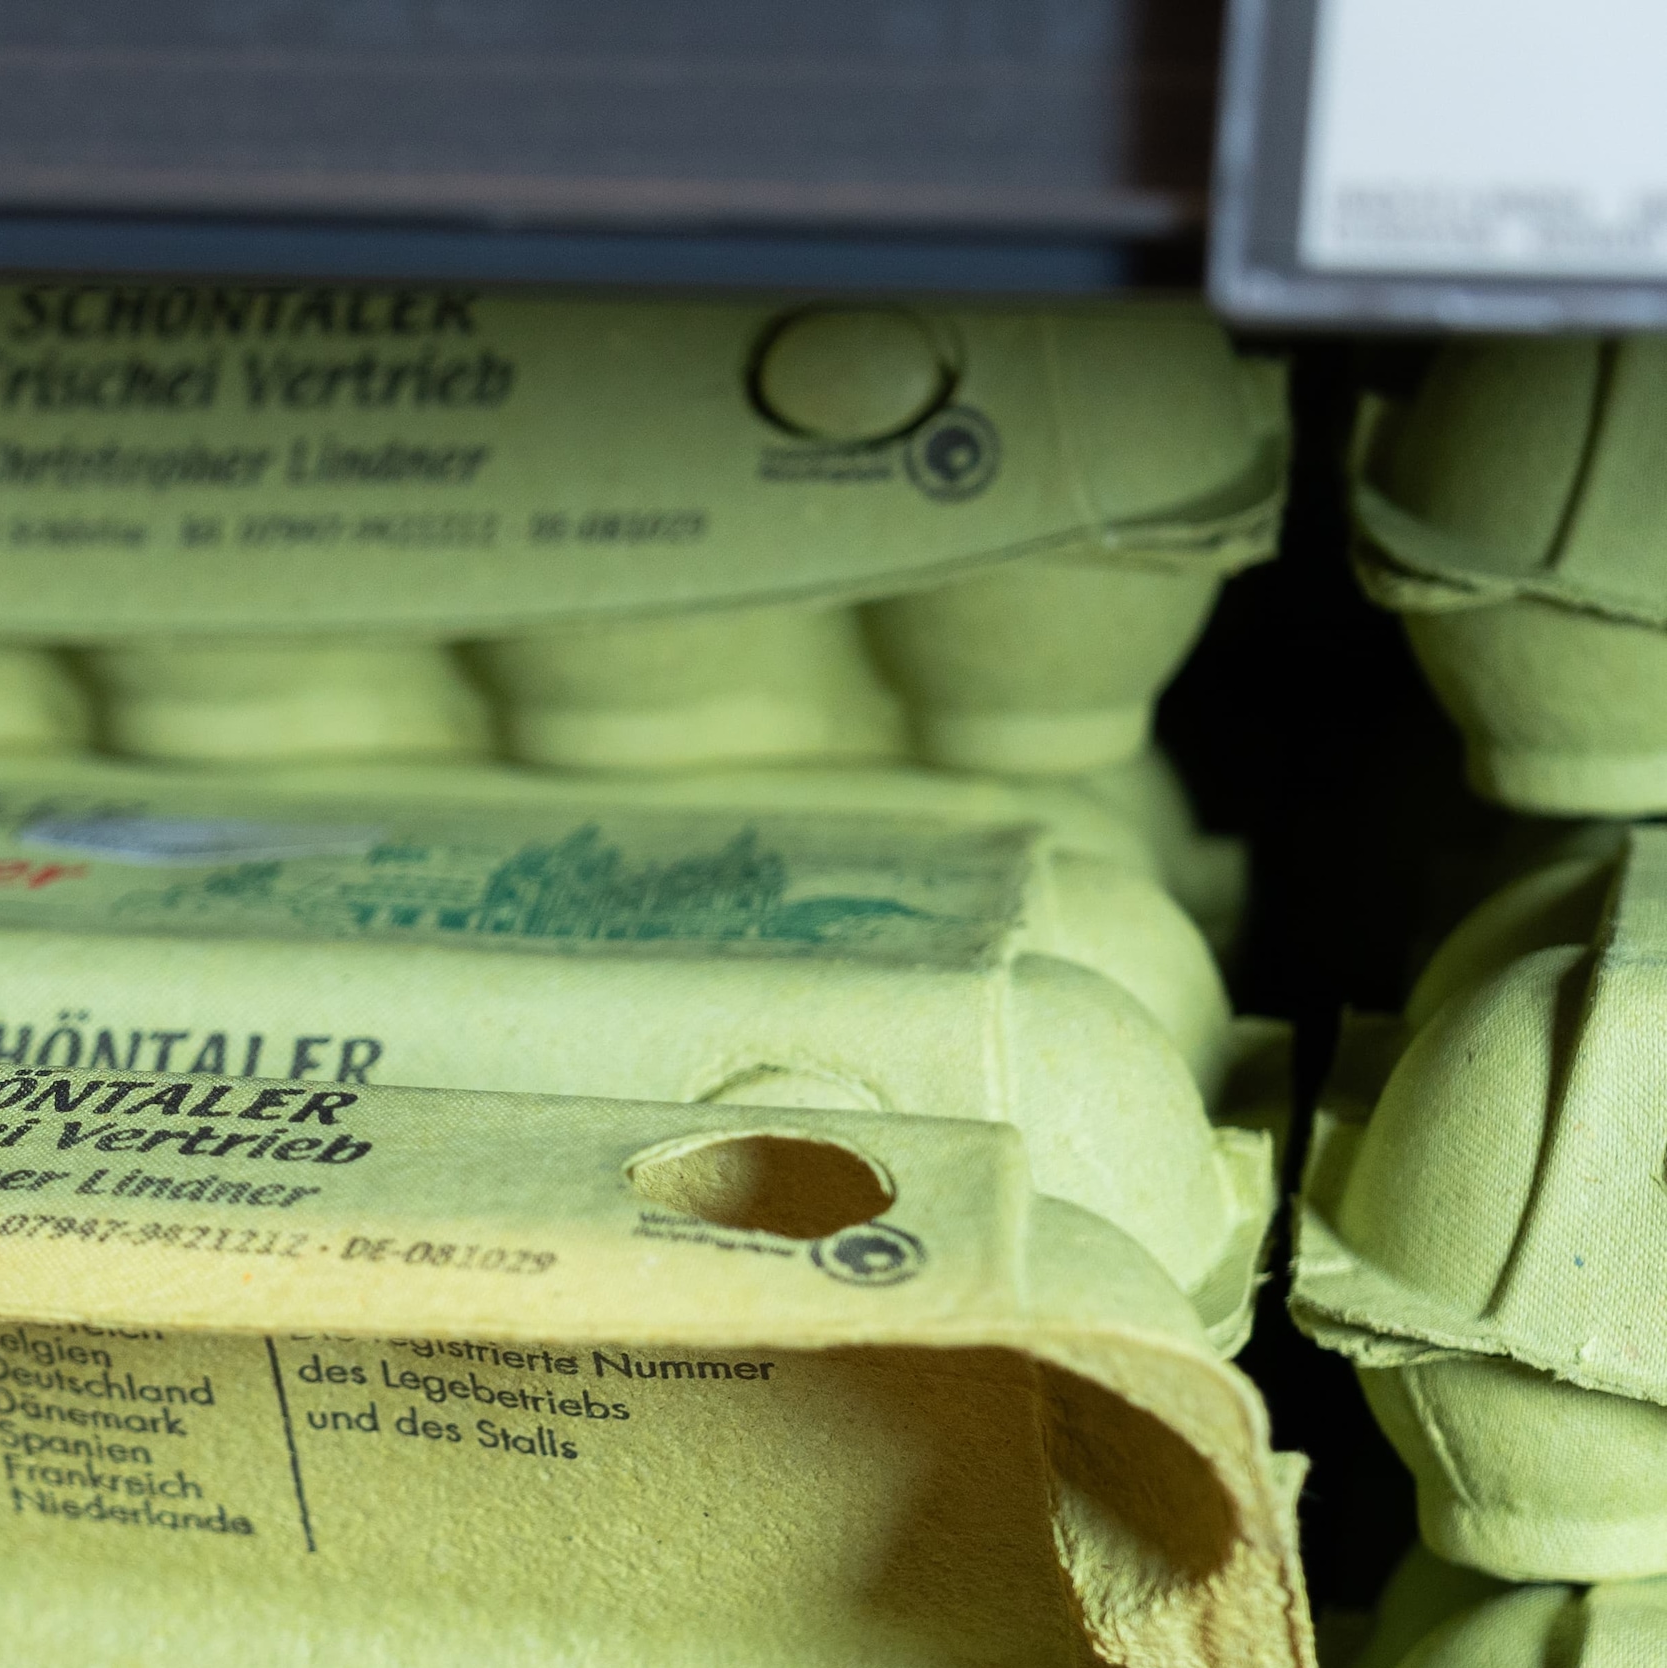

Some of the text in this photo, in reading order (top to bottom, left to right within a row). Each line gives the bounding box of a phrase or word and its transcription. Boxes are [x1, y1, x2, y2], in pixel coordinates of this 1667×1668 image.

[60, 1119, 374, 1168] Vertrieb
[77, 1165, 324, 1209] Lindner
[339, 1235, 559, 1276] DE-081029
[298, 1353, 631, 1421] des Legebetriebs
[593, 1350, 775, 1382] Nummer
[307, 1400, 579, 1460] und des Stalls
[3, 1454, 204, 1499] Frankreich
[11, 1486, 256, 1537] Niederlande
